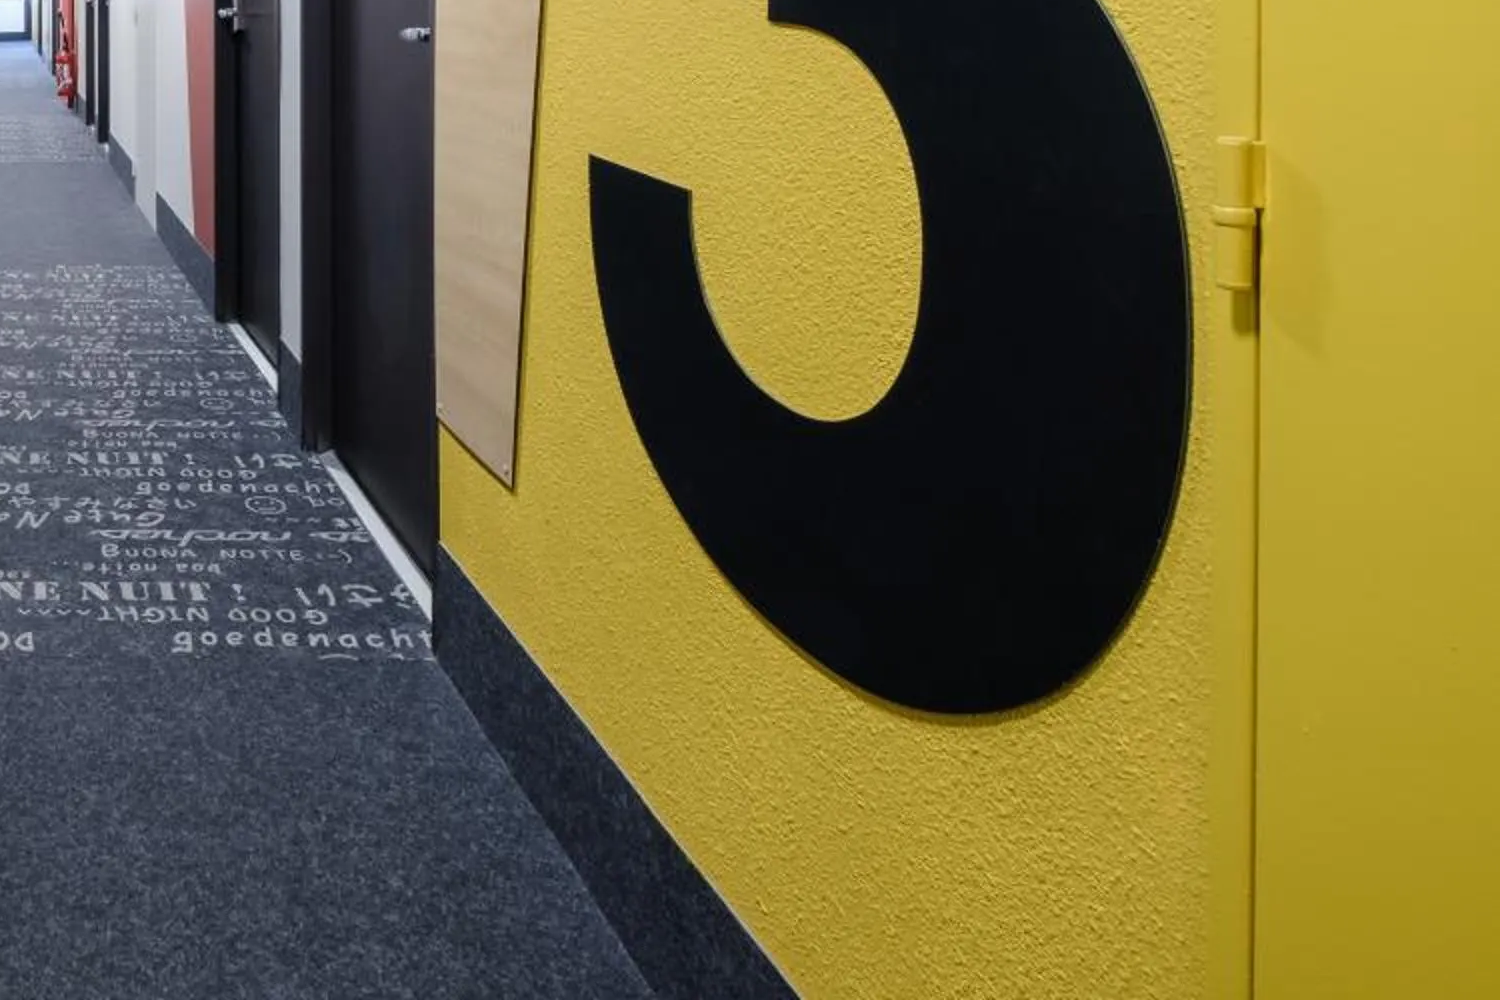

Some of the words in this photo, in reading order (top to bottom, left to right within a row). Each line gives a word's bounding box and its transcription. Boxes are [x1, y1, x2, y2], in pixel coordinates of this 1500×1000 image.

[80, 581, 211, 601] NUIT
[228, 608, 328, 625] GOOD
[171, 627, 433, 653] goedenacht
